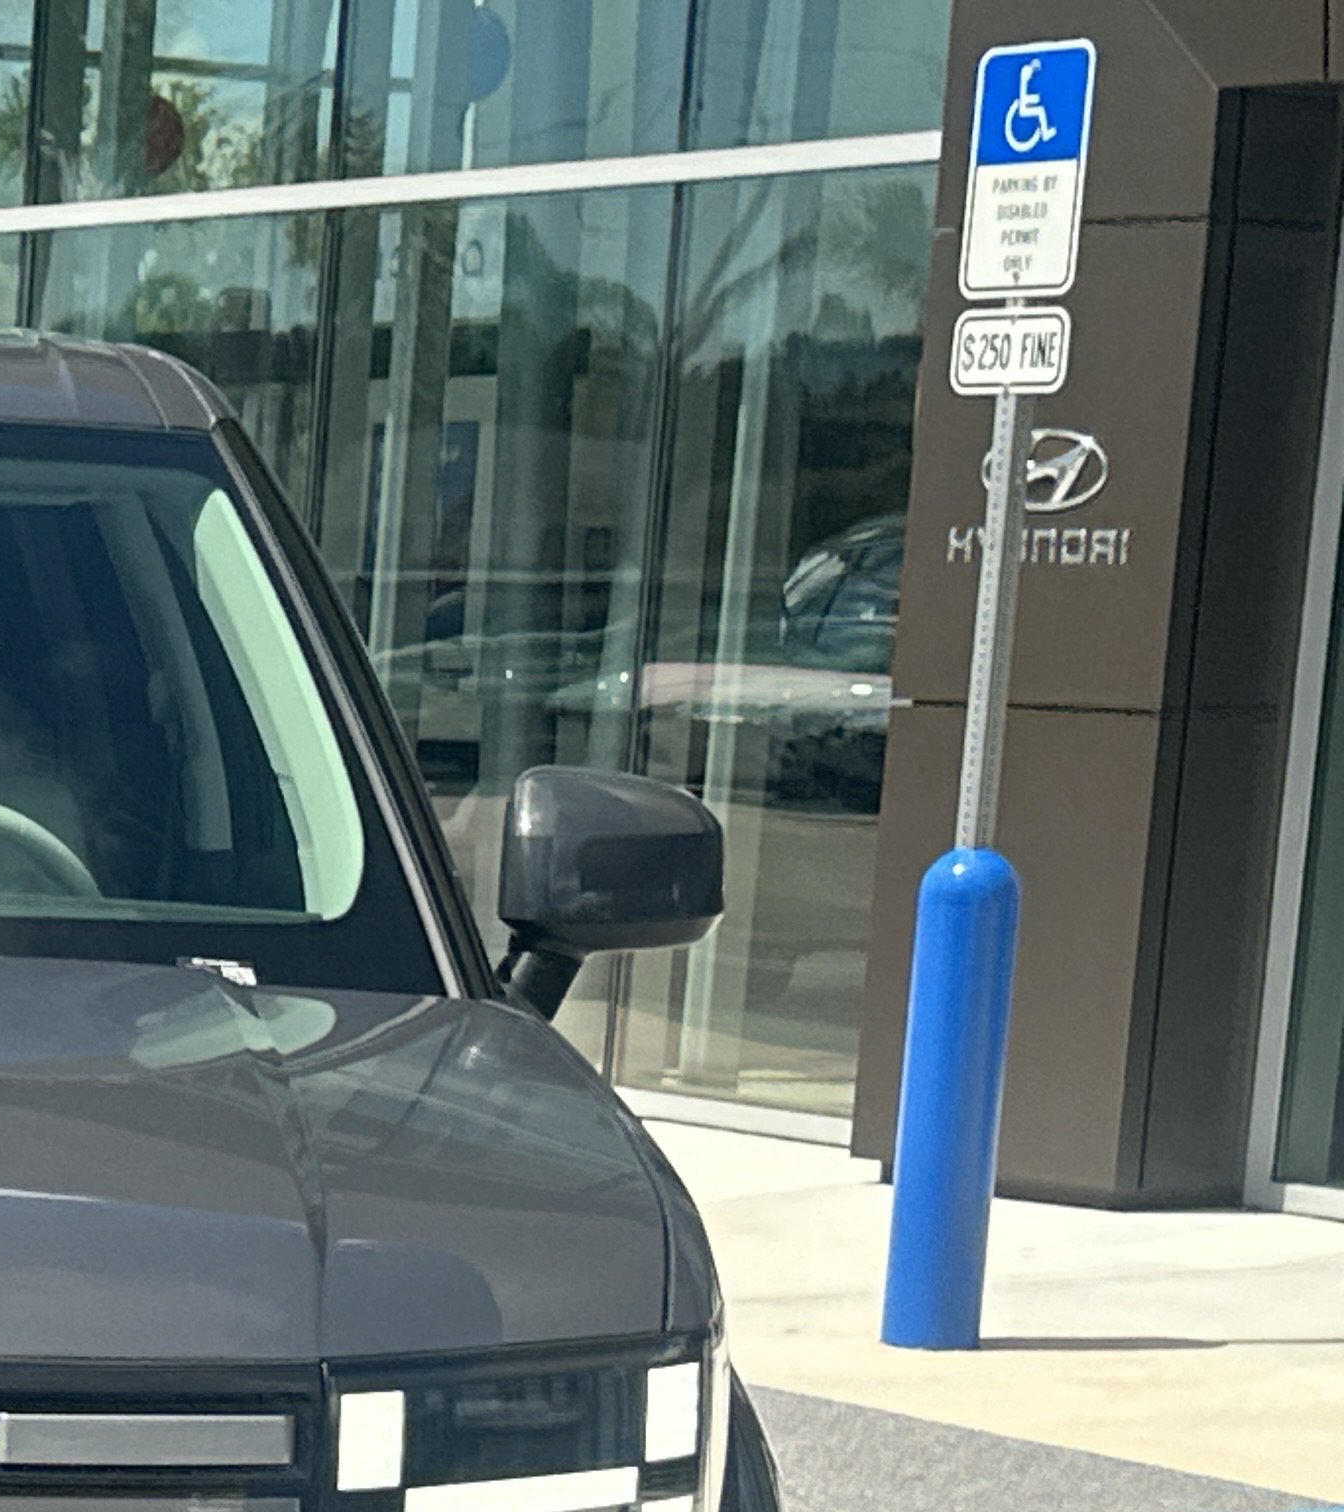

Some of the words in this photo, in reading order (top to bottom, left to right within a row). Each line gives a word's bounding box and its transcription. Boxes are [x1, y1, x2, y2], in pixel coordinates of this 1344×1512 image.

[992, 177, 1039, 193] PARKING
[1043, 175, 1058, 193] BY
[997, 201, 1048, 221] DISABLED
[1001, 228, 1040, 246] PERMIT
[1003, 254, 1032, 272] ONLY
[961, 332, 1011, 373] $250
[1019, 331, 1058, 370] FINE
[946, 526, 1132, 565] HNDAI
